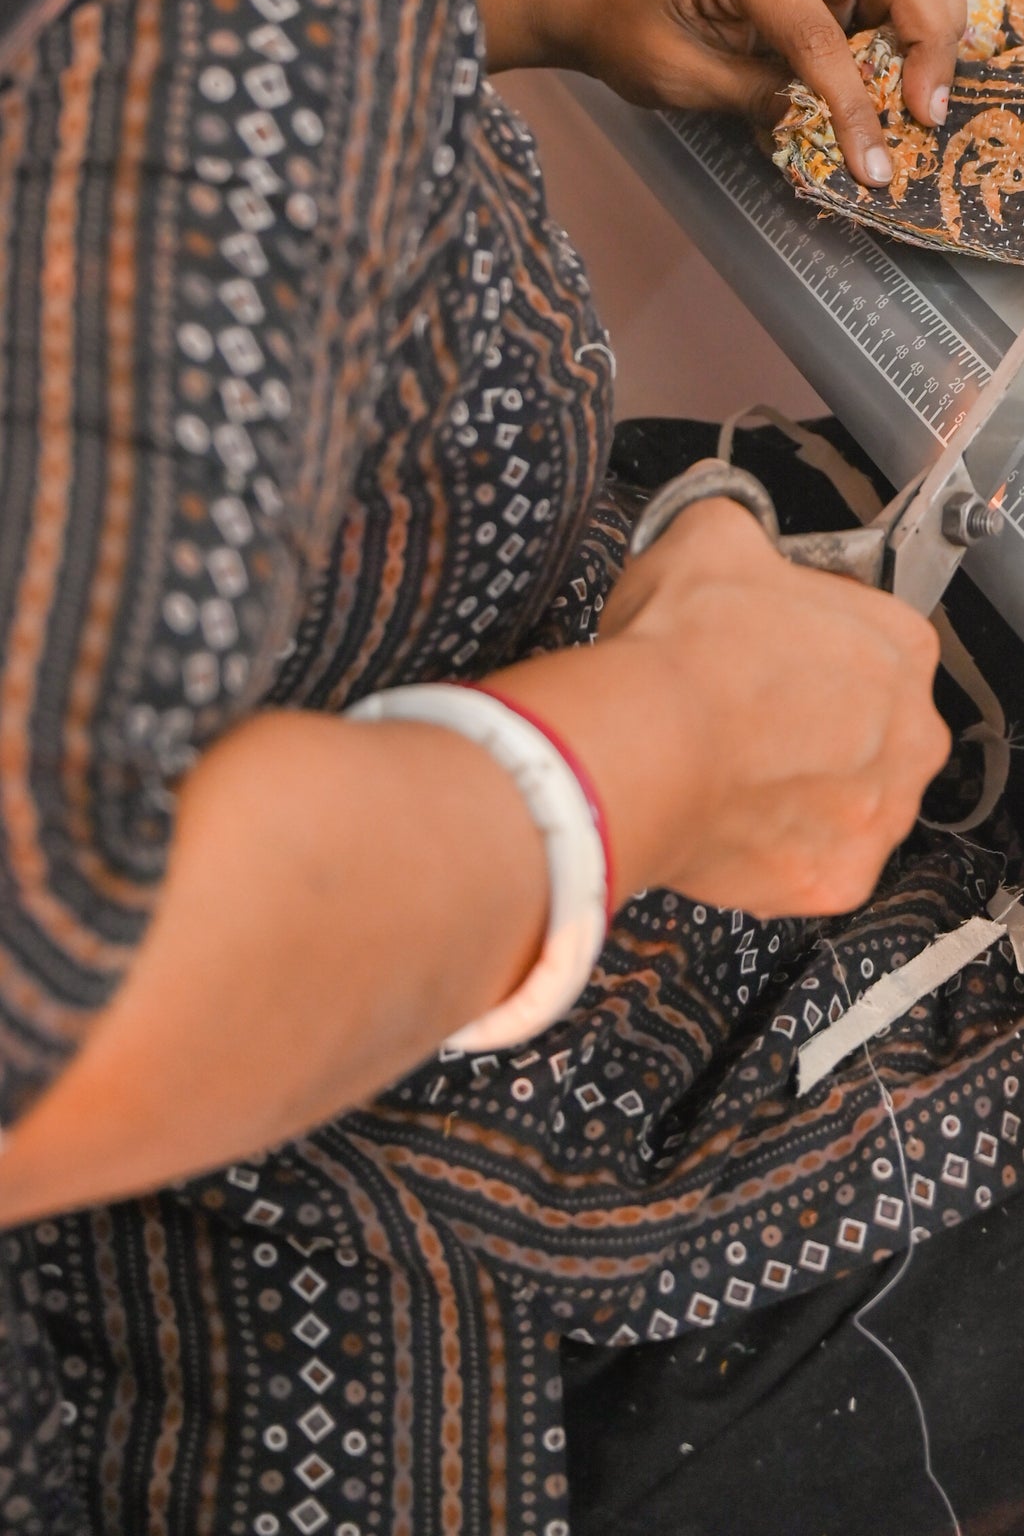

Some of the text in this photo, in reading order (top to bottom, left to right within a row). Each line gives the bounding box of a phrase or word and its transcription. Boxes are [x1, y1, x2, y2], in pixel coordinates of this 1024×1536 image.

[799, 234, 810, 247] 41
[812, 249, 825, 264] 42
[825, 264, 839, 278] 43
[839, 280, 852, 294] 44
[853, 296, 867, 310] 45
[867, 312, 880, 326] 46
[881, 328, 896, 342] 47
[895, 344, 909, 359] 48
[910, 361, 925, 376] 49
[924, 376, 939, 393] 50
[939, 393, 954, 411] 51
[954, 411, 967, 425] 5
[1007, 470, 1019, 482] 5
[839, 255, 854, 269] 17
[875, 294, 889, 309] 18
[911, 335, 927, 350] 19
[948, 377, 965, 394] 20
